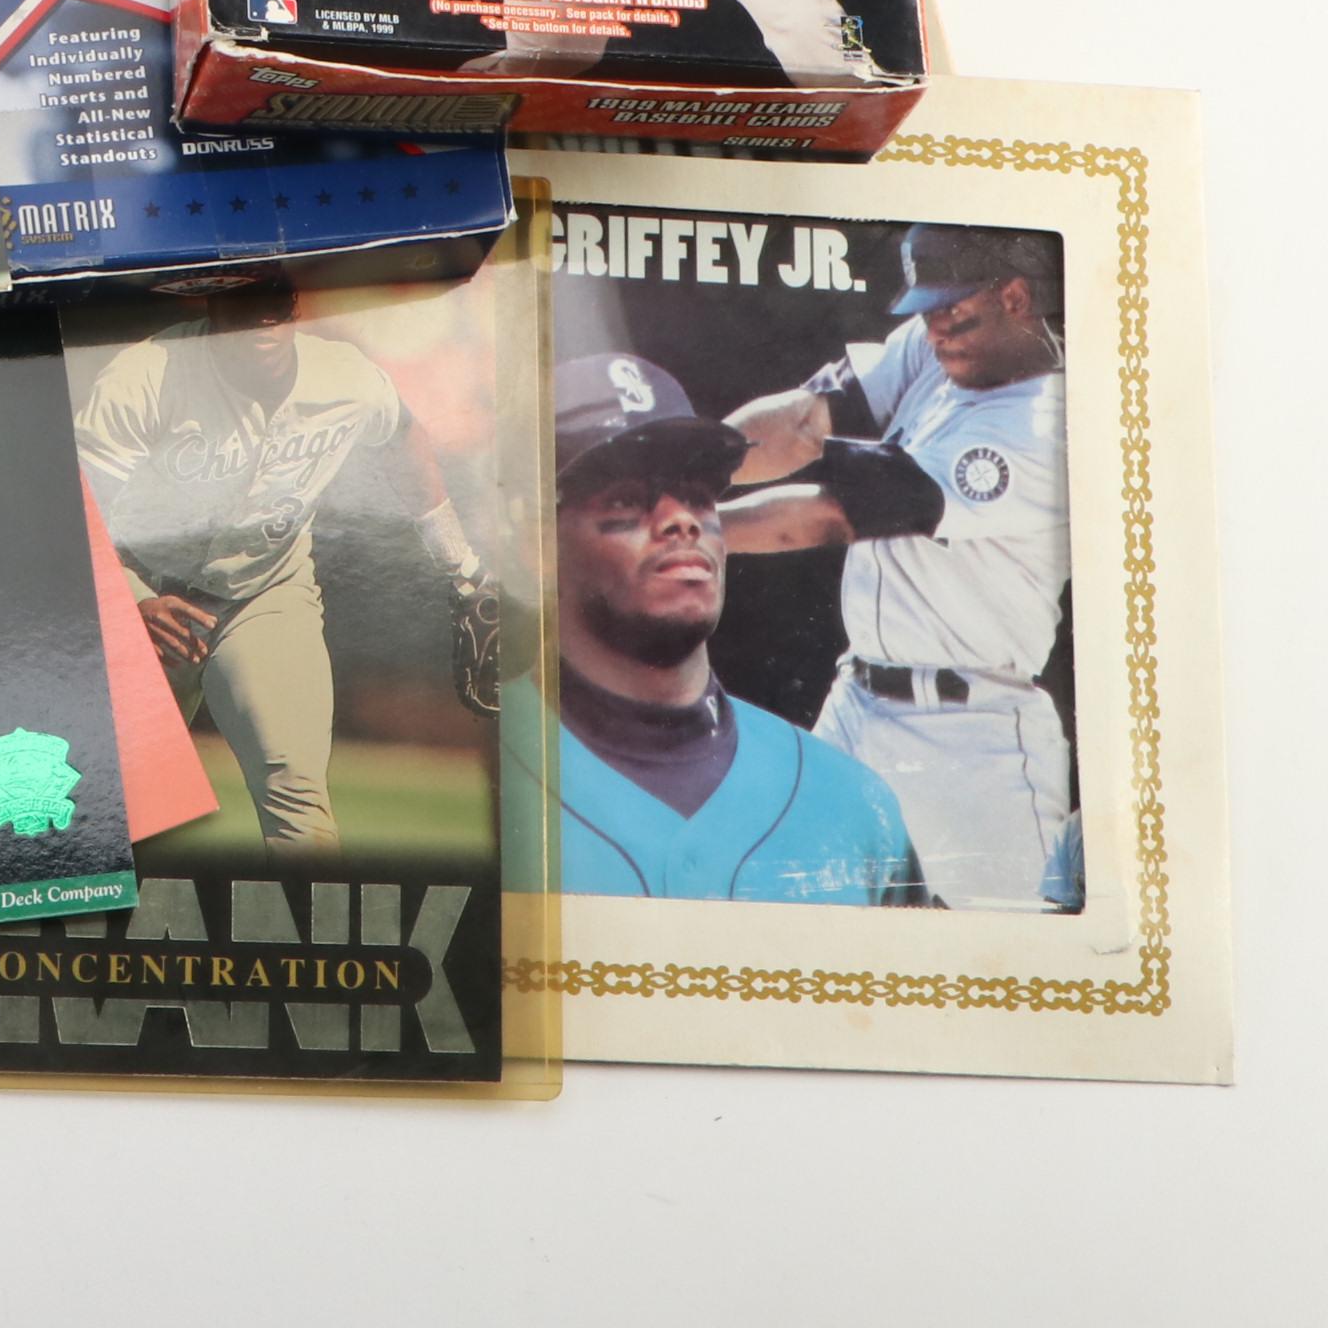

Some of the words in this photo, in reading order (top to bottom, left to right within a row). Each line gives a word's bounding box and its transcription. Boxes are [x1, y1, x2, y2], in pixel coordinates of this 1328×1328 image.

[316, 10, 361, 22] LICENSED
[380, 13, 399, 24] MLB
[453, 2, 501, 17] purchase
[566, 7, 587, 19] See
[590, 9, 614, 22] pack
[49, 28, 140, 44] Featuring
[372, 24, 394, 34] 1999
[533, 22, 569, 33] bottom
[30, 47, 143, 67] Individually
[49, 66, 146, 85] Numbered
[41, 92, 106, 107] Inserts
[114, 86, 148, 99] and
[587, 98, 657, 109] 1999
[660, 100, 750, 113] MAJOR
[752, 102, 847, 114] LEAGUE
[78, 109, 151, 124] All-New
[614, 112, 736, 125] BASEBALL
[746, 115, 836, 127] CARDS
[56, 126, 153, 146] Statistical
[723, 136, 796, 147] SERIES
[182, 137, 274, 155] DONRUSS
[61, 148, 157, 166] Standouts
[18, 199, 116, 235] MATRIX
[548, 213, 769, 285] GRIFFEY
[778, 227, 866, 292] JR.
[2, 887, 43, 909] Deck
[47, 881, 123, 905] Company
